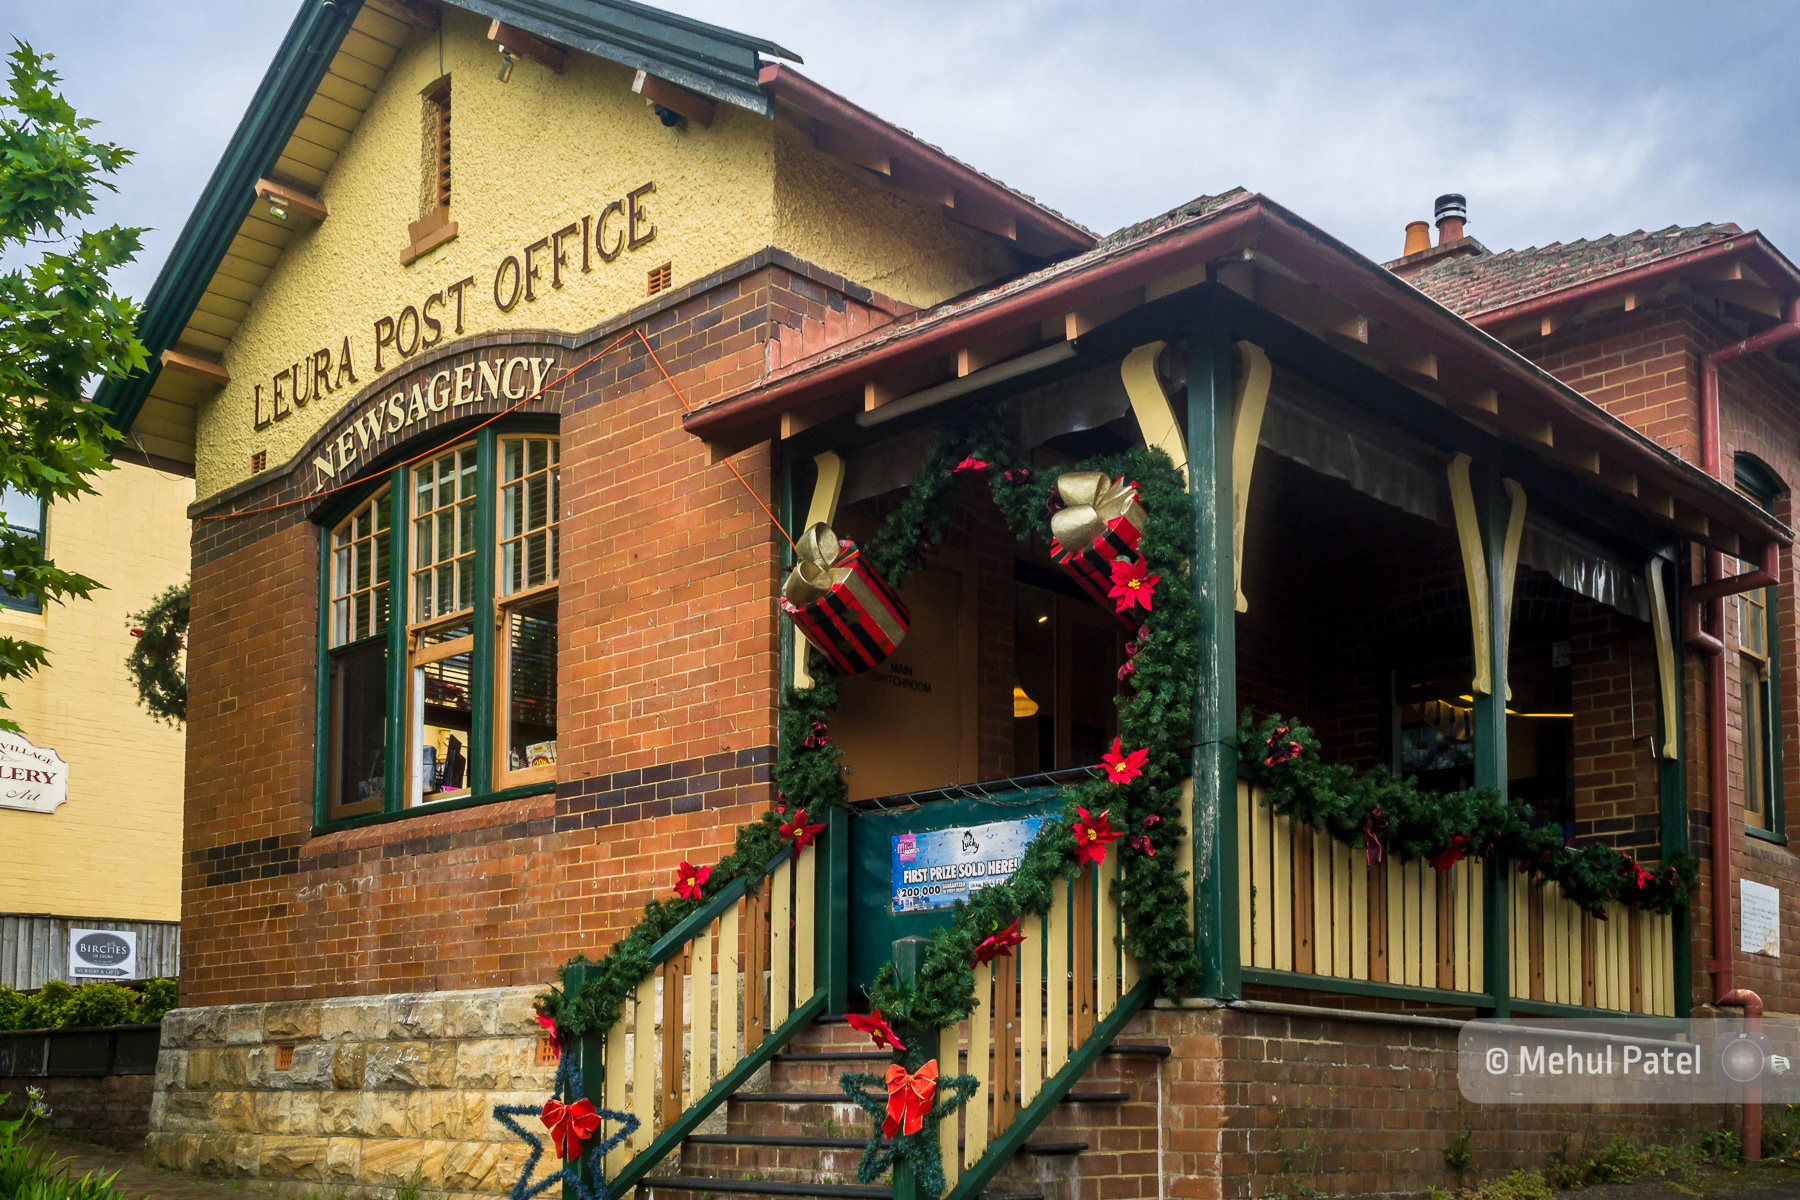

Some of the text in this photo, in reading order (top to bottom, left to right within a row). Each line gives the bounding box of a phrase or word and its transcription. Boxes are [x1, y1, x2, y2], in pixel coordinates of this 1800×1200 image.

[253, 181, 658, 431] LEURA POST OFFICE
[312, 356, 555, 492] NEWSAGENCY
[891, 662, 913, 676] MAIN
[871, 671, 932, 693] SWITCHROOM
[1, 743, 54, 765] VILLAGE
[6, 790, 41, 801] Art
[962, 838, 979, 854] Lucky
[903, 857, 1018, 885] FIRST PRIZE SOLD HERE!
[897, 885, 941, 898] $200,000
[80, 942, 127, 955] BIRCHES
